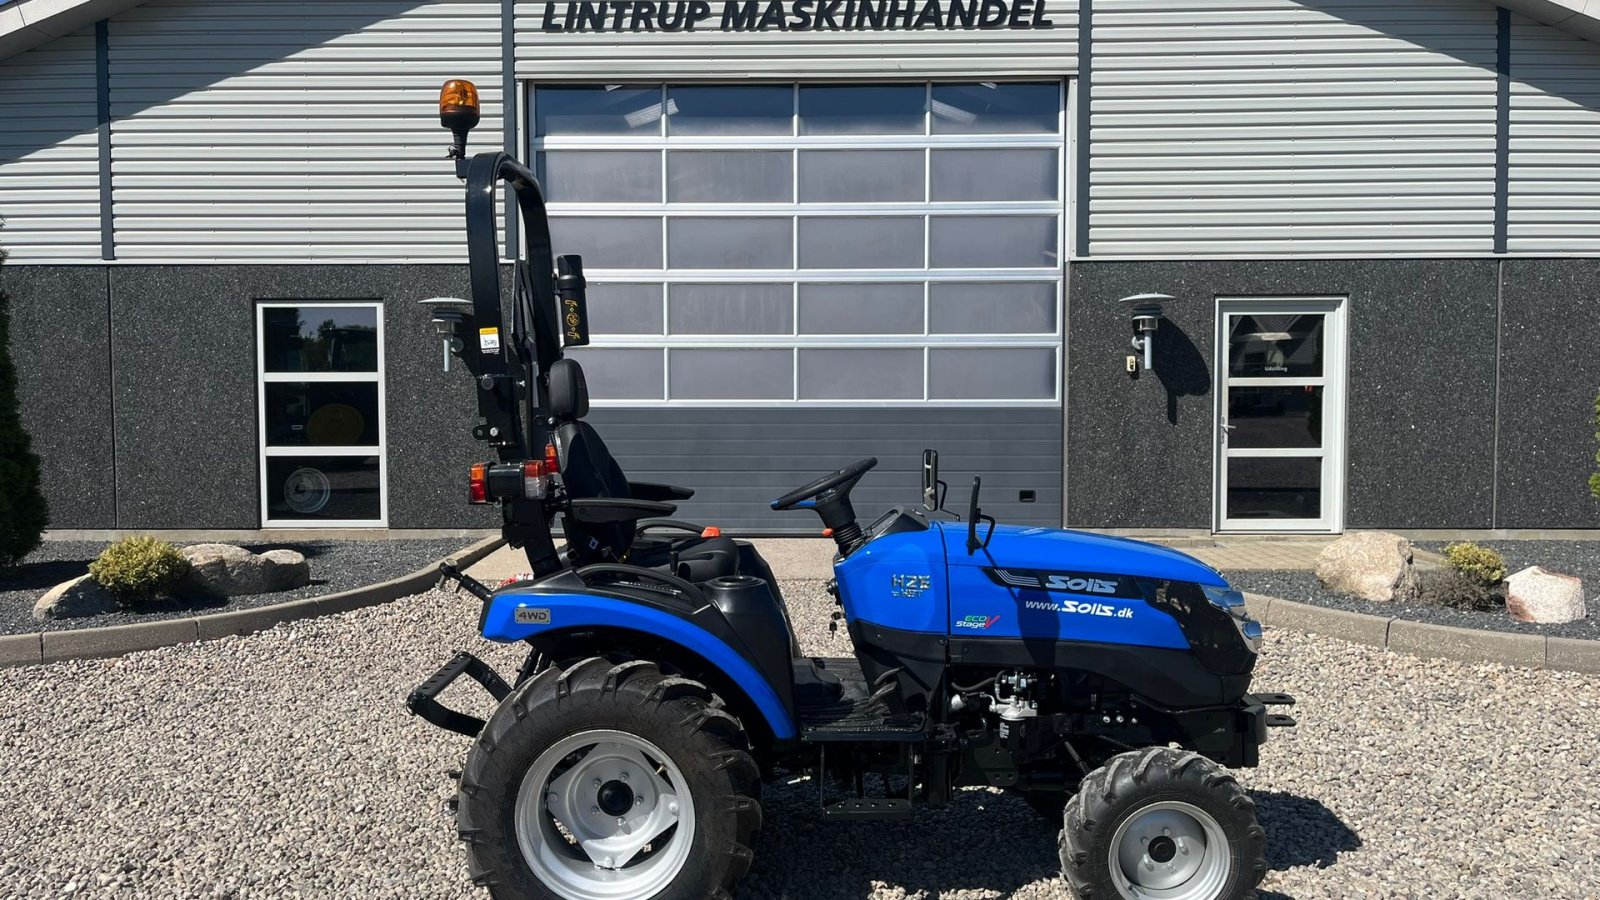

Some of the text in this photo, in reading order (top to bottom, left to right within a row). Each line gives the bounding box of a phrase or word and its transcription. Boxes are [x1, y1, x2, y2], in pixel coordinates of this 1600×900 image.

[542, 0, 1053, 30] LINTRUP MASKINHANDEL
[518, 611, 547, 620] 4WD
